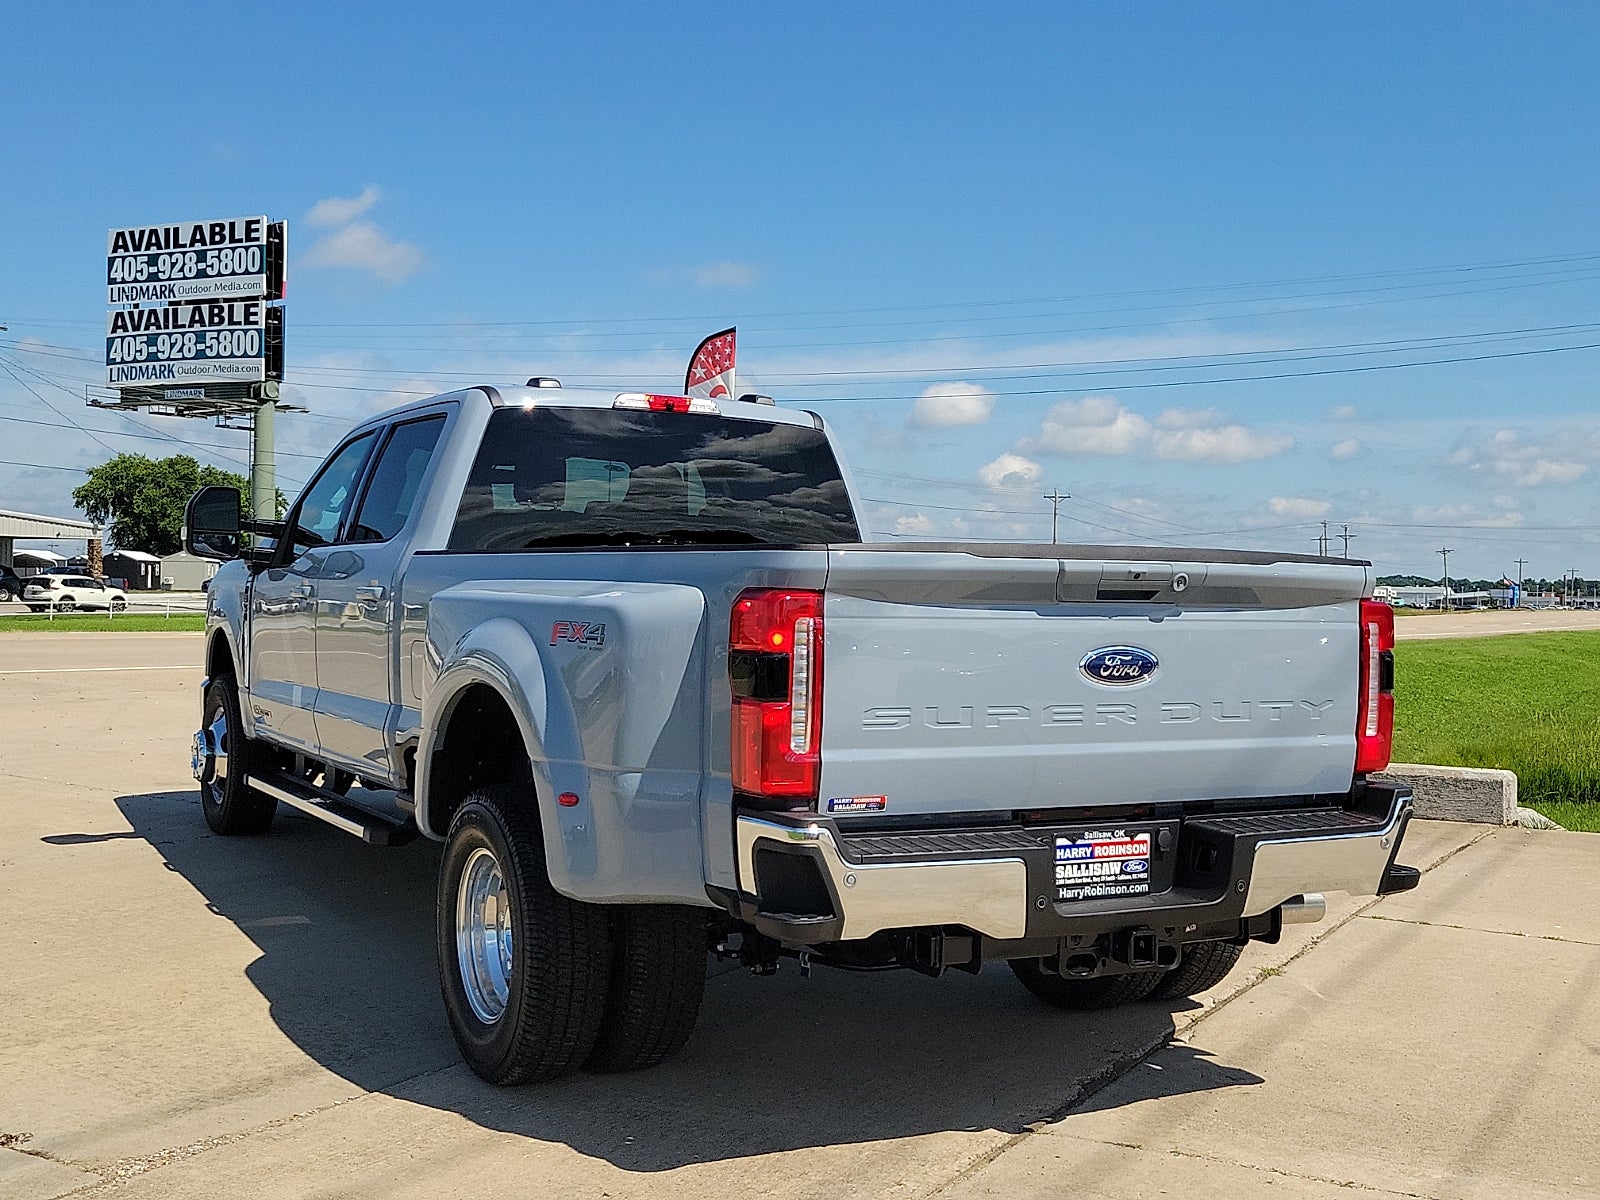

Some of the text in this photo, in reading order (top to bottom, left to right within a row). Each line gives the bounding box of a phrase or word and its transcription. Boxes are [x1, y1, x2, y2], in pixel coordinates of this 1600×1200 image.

[111, 219, 261, 254] AVAILABLE
[110, 246, 261, 282] 405-928-5800
[110, 280, 261, 303] LINDMARK Outdoor Media.com
[110, 303, 260, 335] AVAILABLE
[109, 330, 260, 363] 405-928-5800
[109, 363, 260, 383] LINDMARK Outdoor Media.com
[549, 620, 606, 647] FX4
[1100, 654, 1143, 677] Ford
[862, 699, 1334, 730] SUPER DUTY
[1114, 829, 1125, 838] OK
[1056, 843, 1147, 859] HARRY ROBINSON
[1056, 861, 1122, 879] SALLISAW
[1060, 884, 1148, 899] HarryRobinson.com
